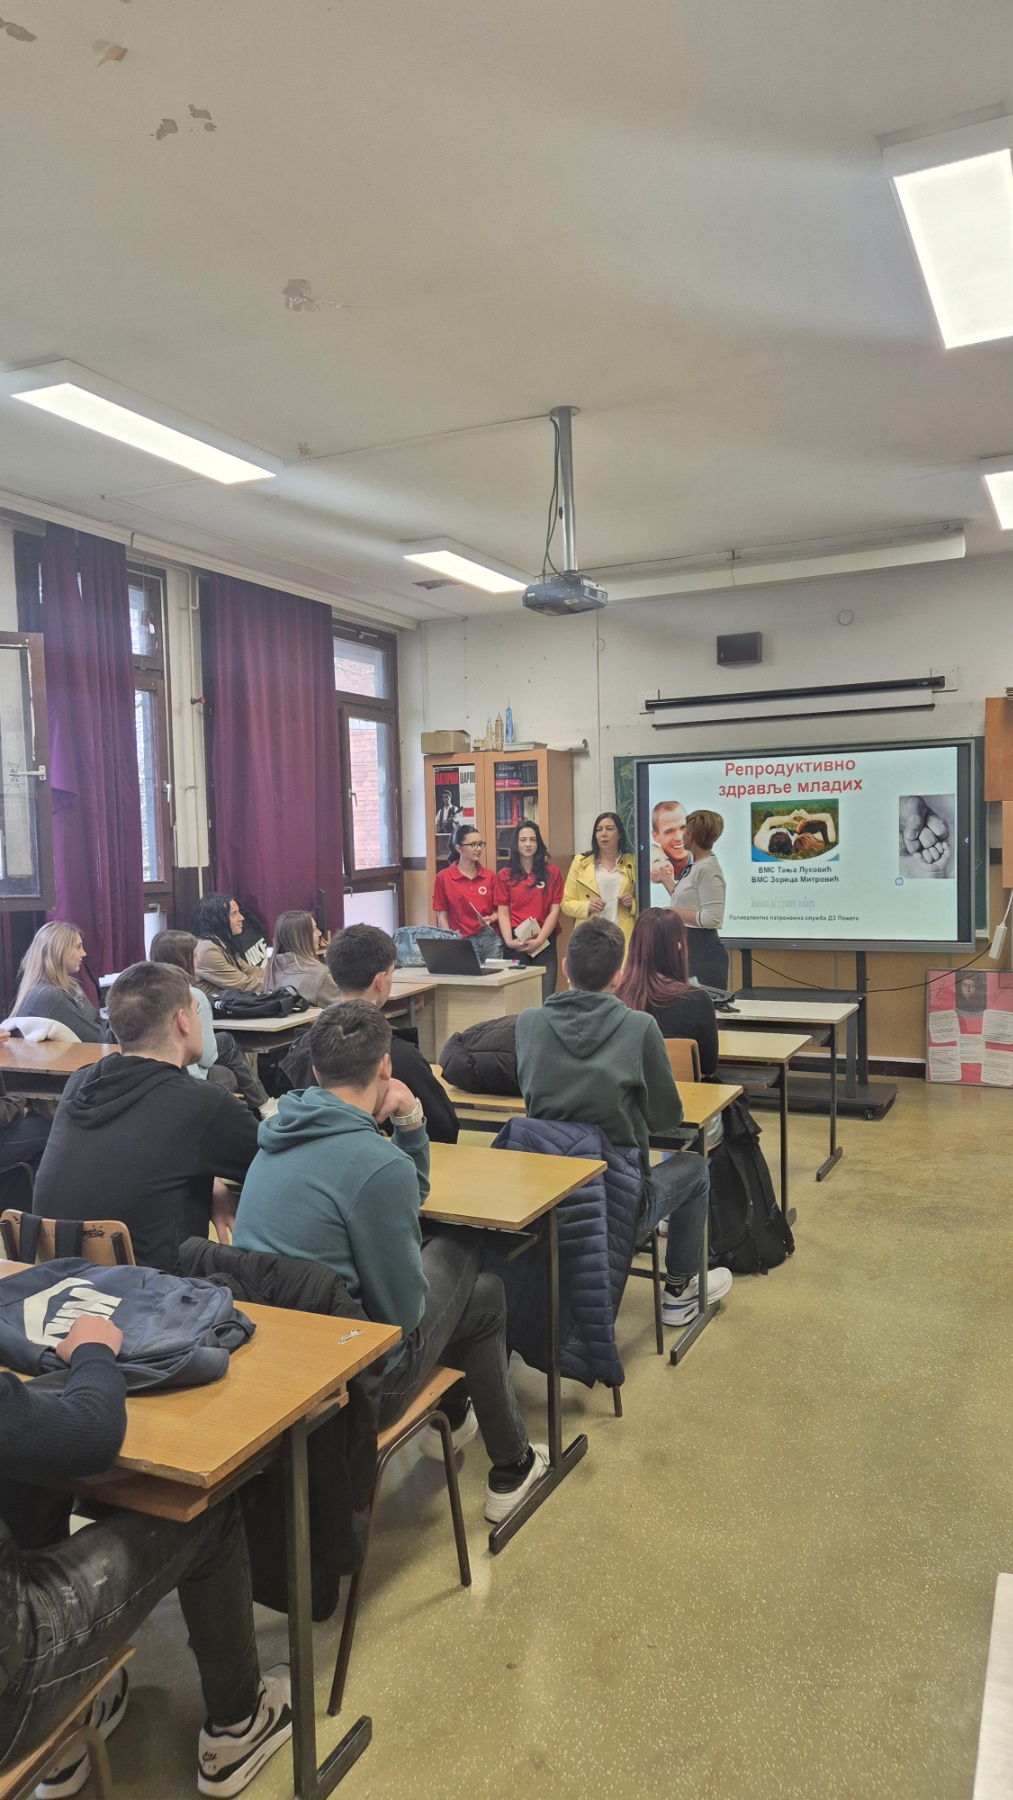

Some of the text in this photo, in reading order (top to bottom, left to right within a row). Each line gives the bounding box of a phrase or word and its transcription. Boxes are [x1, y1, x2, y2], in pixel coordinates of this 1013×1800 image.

[725, 760, 855, 778] Репродуктивно
[719, 780, 862, 798] здравље младих
[758, 866, 832, 875] ВМС Тања Луковић
[770, 876, 798, 884] Зорица
[800, 875, 839, 884] Митровић
